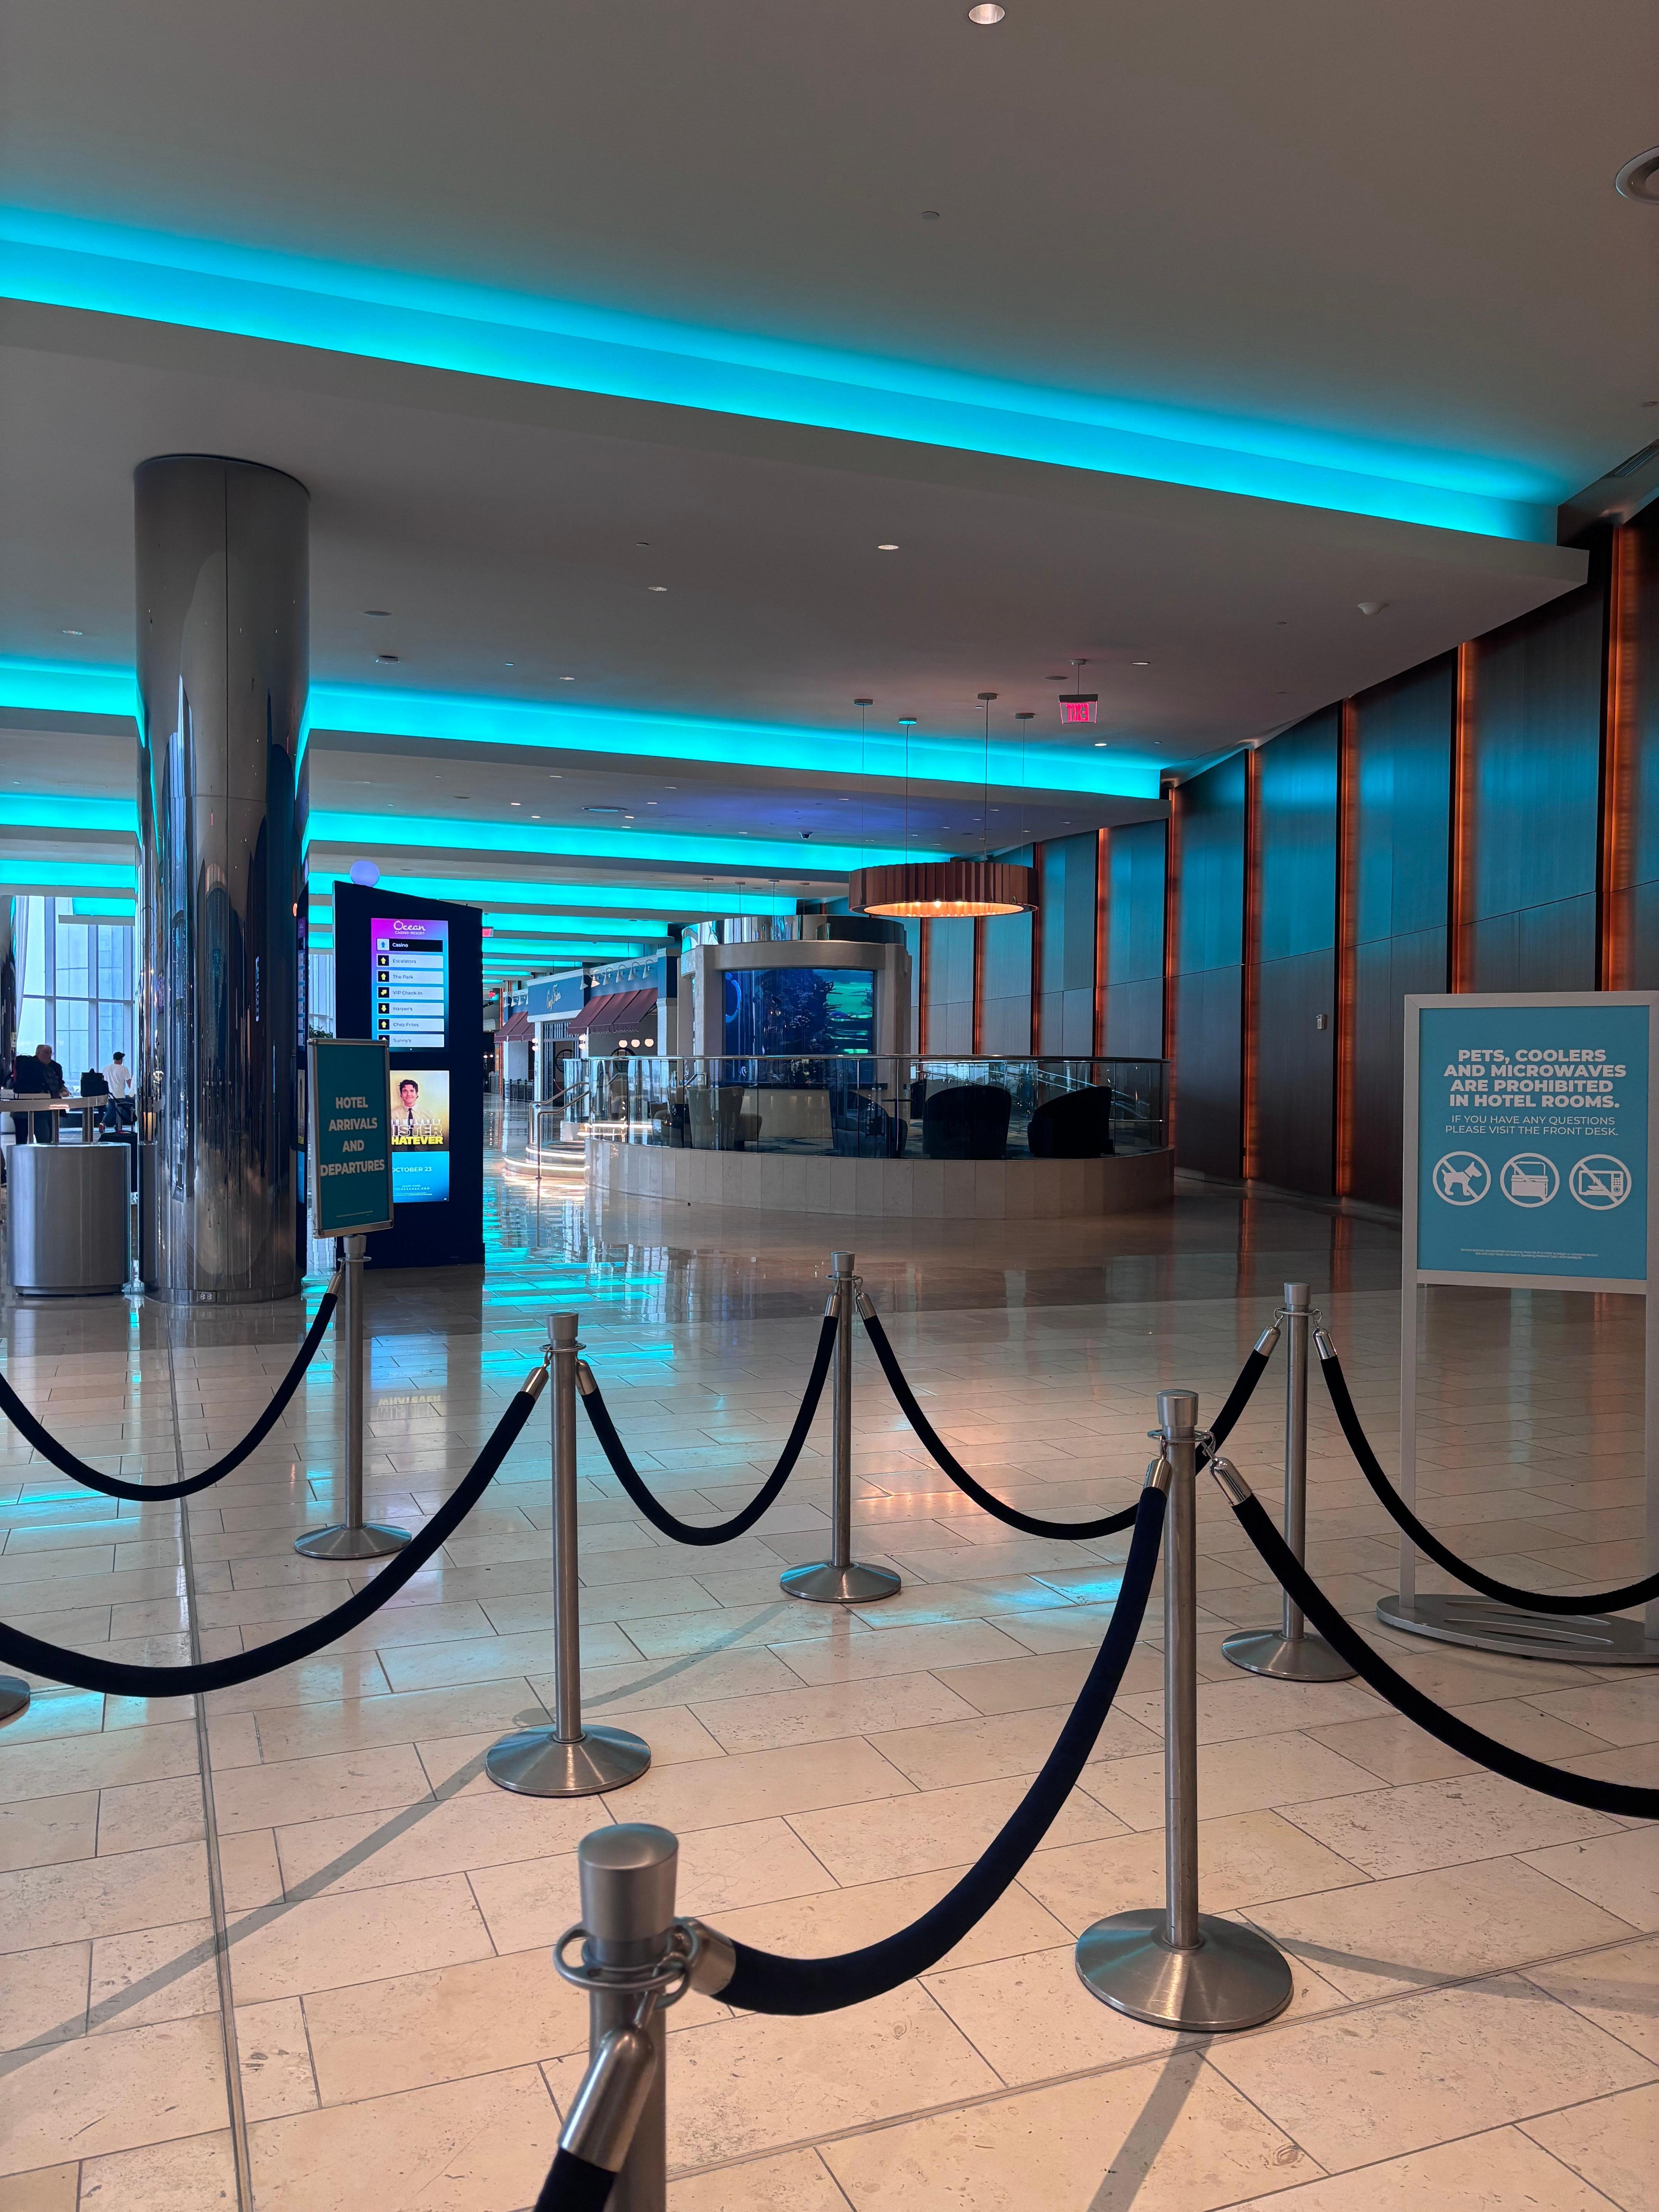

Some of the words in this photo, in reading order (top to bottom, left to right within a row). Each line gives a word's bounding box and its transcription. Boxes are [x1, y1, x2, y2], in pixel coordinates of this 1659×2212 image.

[393, 921, 426, 931] Ocean
[1458, 1049, 1510, 1064] PETS,
[1515, 1049, 1606, 1062] COOLERS
[1443, 1065, 1485, 1077] AND
[1491, 1065, 1626, 1077] MICROWAVES
[1450, 1079, 1488, 1092] ARE
[1494, 1080, 1613, 1092] PROHIBITED
[335, 1097, 368, 1109] HOTEL
[1450, 1094, 1468, 1106] IN
[1474, 1094, 1536, 1107] HOTEL
[1542, 1095, 1620, 1108] ROOMS.
[328, 1118, 378, 1131] ARRIVALS
[1491, 1116, 1520, 1124] HAVE
[1549, 1116, 1615, 1125] QUESTIONS
[391, 1124, 443, 1137] ISTER
[1446, 1125, 1486, 1133] PLEASE
[1489, 1126, 1515, 1134] VISIT
[1518, 1126, 1540, 1134] THE
[1543, 1127, 1582, 1135] FRONT
[1585, 1127, 1618, 1135] DESK.
[342, 1140, 364, 1152] AND
[391, 1136, 443, 1145] HATEVER
[320, 1159, 385, 1177] DEPARTURES
